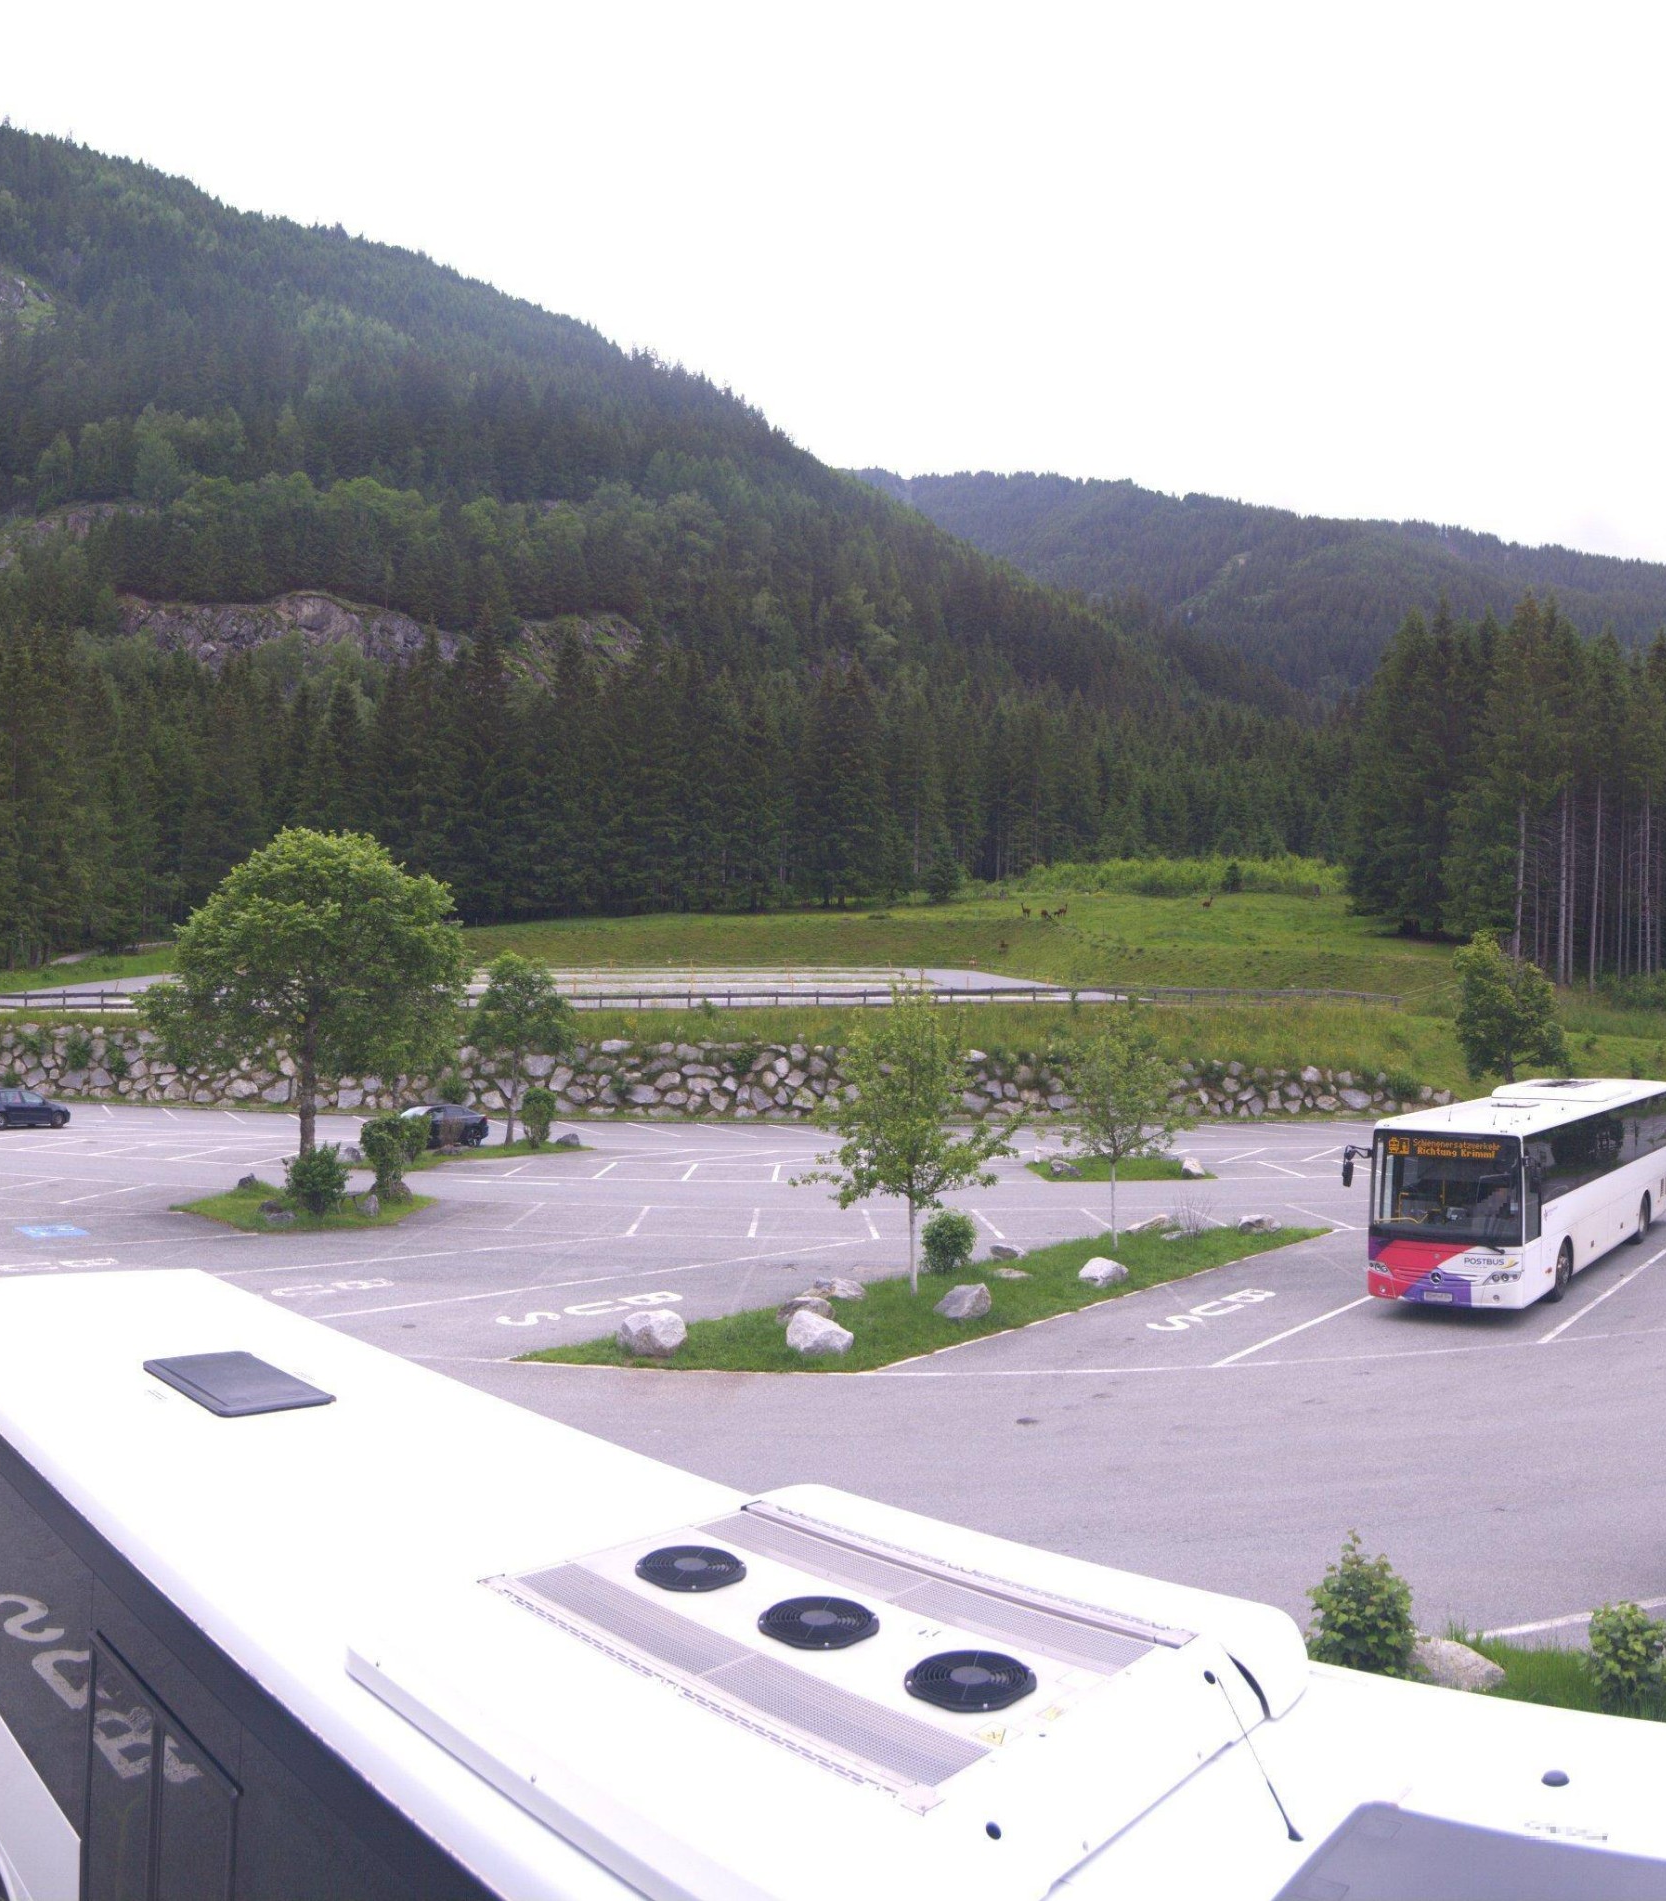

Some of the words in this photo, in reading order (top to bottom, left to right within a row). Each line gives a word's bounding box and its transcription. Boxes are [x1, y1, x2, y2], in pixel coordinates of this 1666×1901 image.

[1417, 1146, 1457, 1157] Richtung
[1461, 1150, 1496, 1158] Krimml
[1464, 1257, 1505, 1266] POSTBUS
[271, 1278, 394, 1296] BU
[496, 1291, 683, 1326] BUS
[1146, 1288, 1276, 1331] BUS
